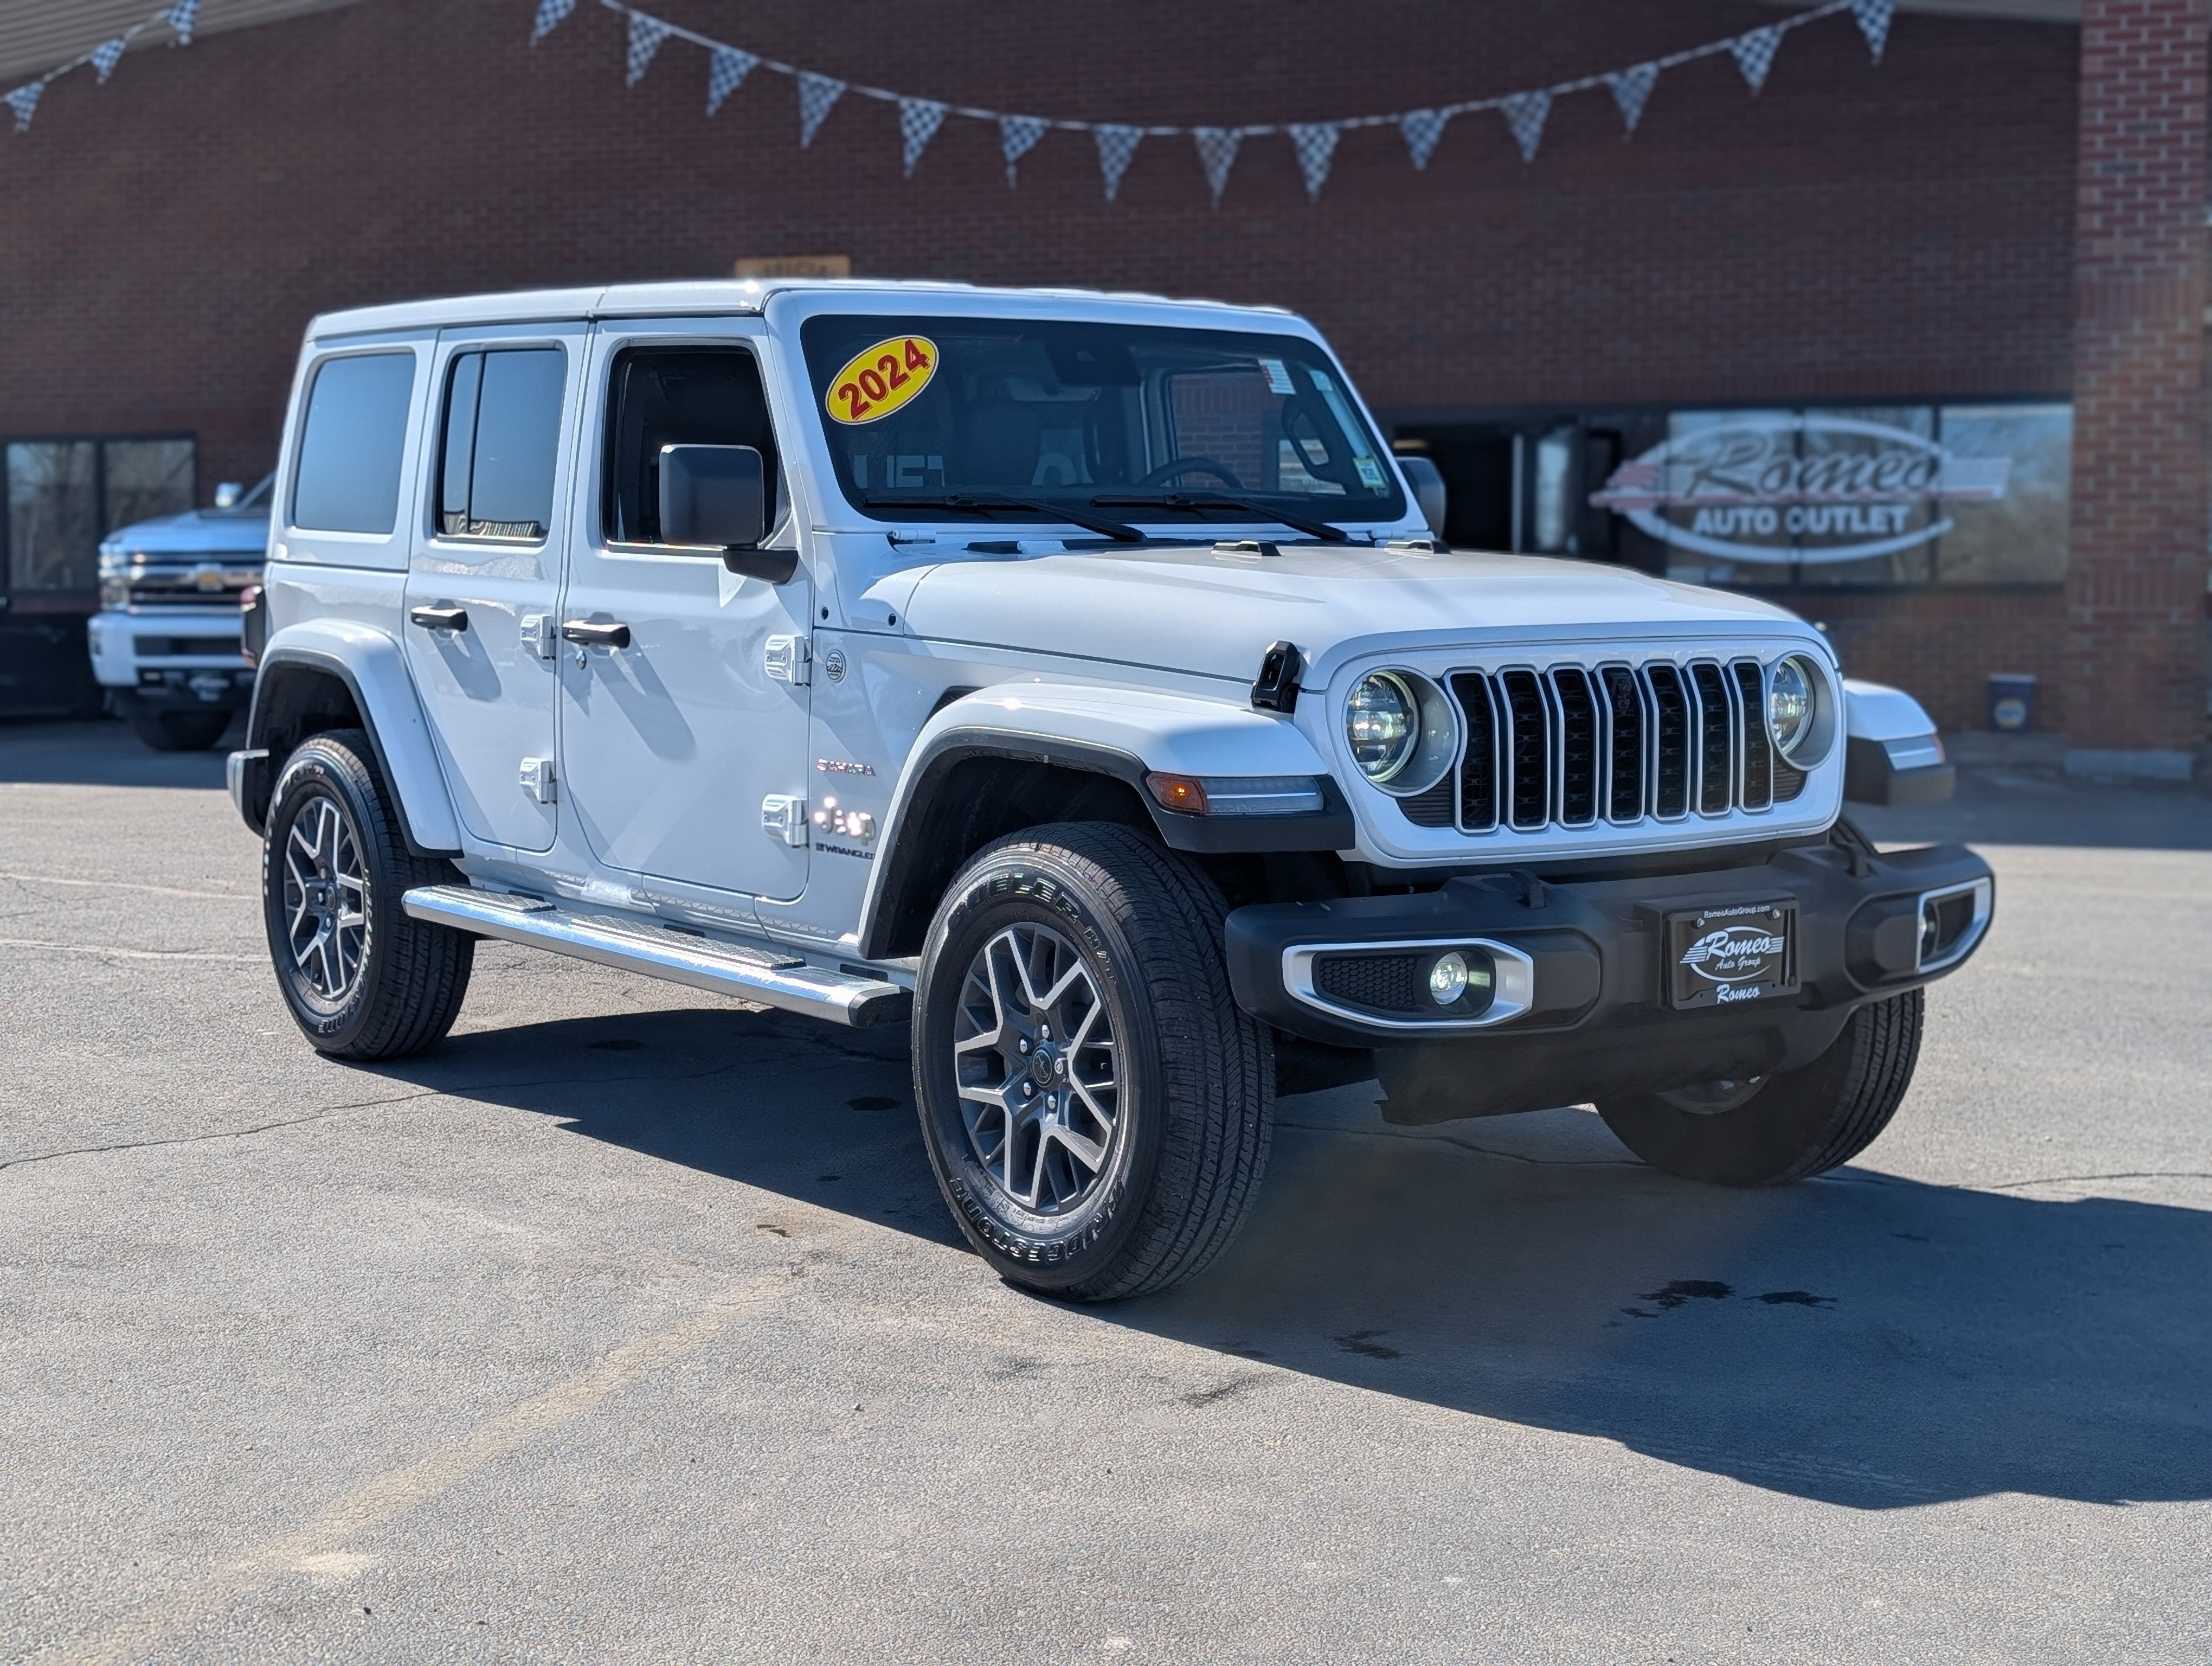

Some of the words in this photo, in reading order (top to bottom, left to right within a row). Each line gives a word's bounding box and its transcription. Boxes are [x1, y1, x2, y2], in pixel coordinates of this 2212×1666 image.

[838, 338, 930, 421] 2024
[1667, 434, 1939, 499] Romeo
[1693, 507, 1778, 535] AUTO
[1785, 507, 1909, 535] OUTLET
[813, 797, 877, 846] Jep
[1706, 931, 1771, 960] Romeo
[1715, 959, 1735, 971] Auto
[1738, 956, 1761, 971] Group
[1716, 984, 1760, 1004] Romeo
